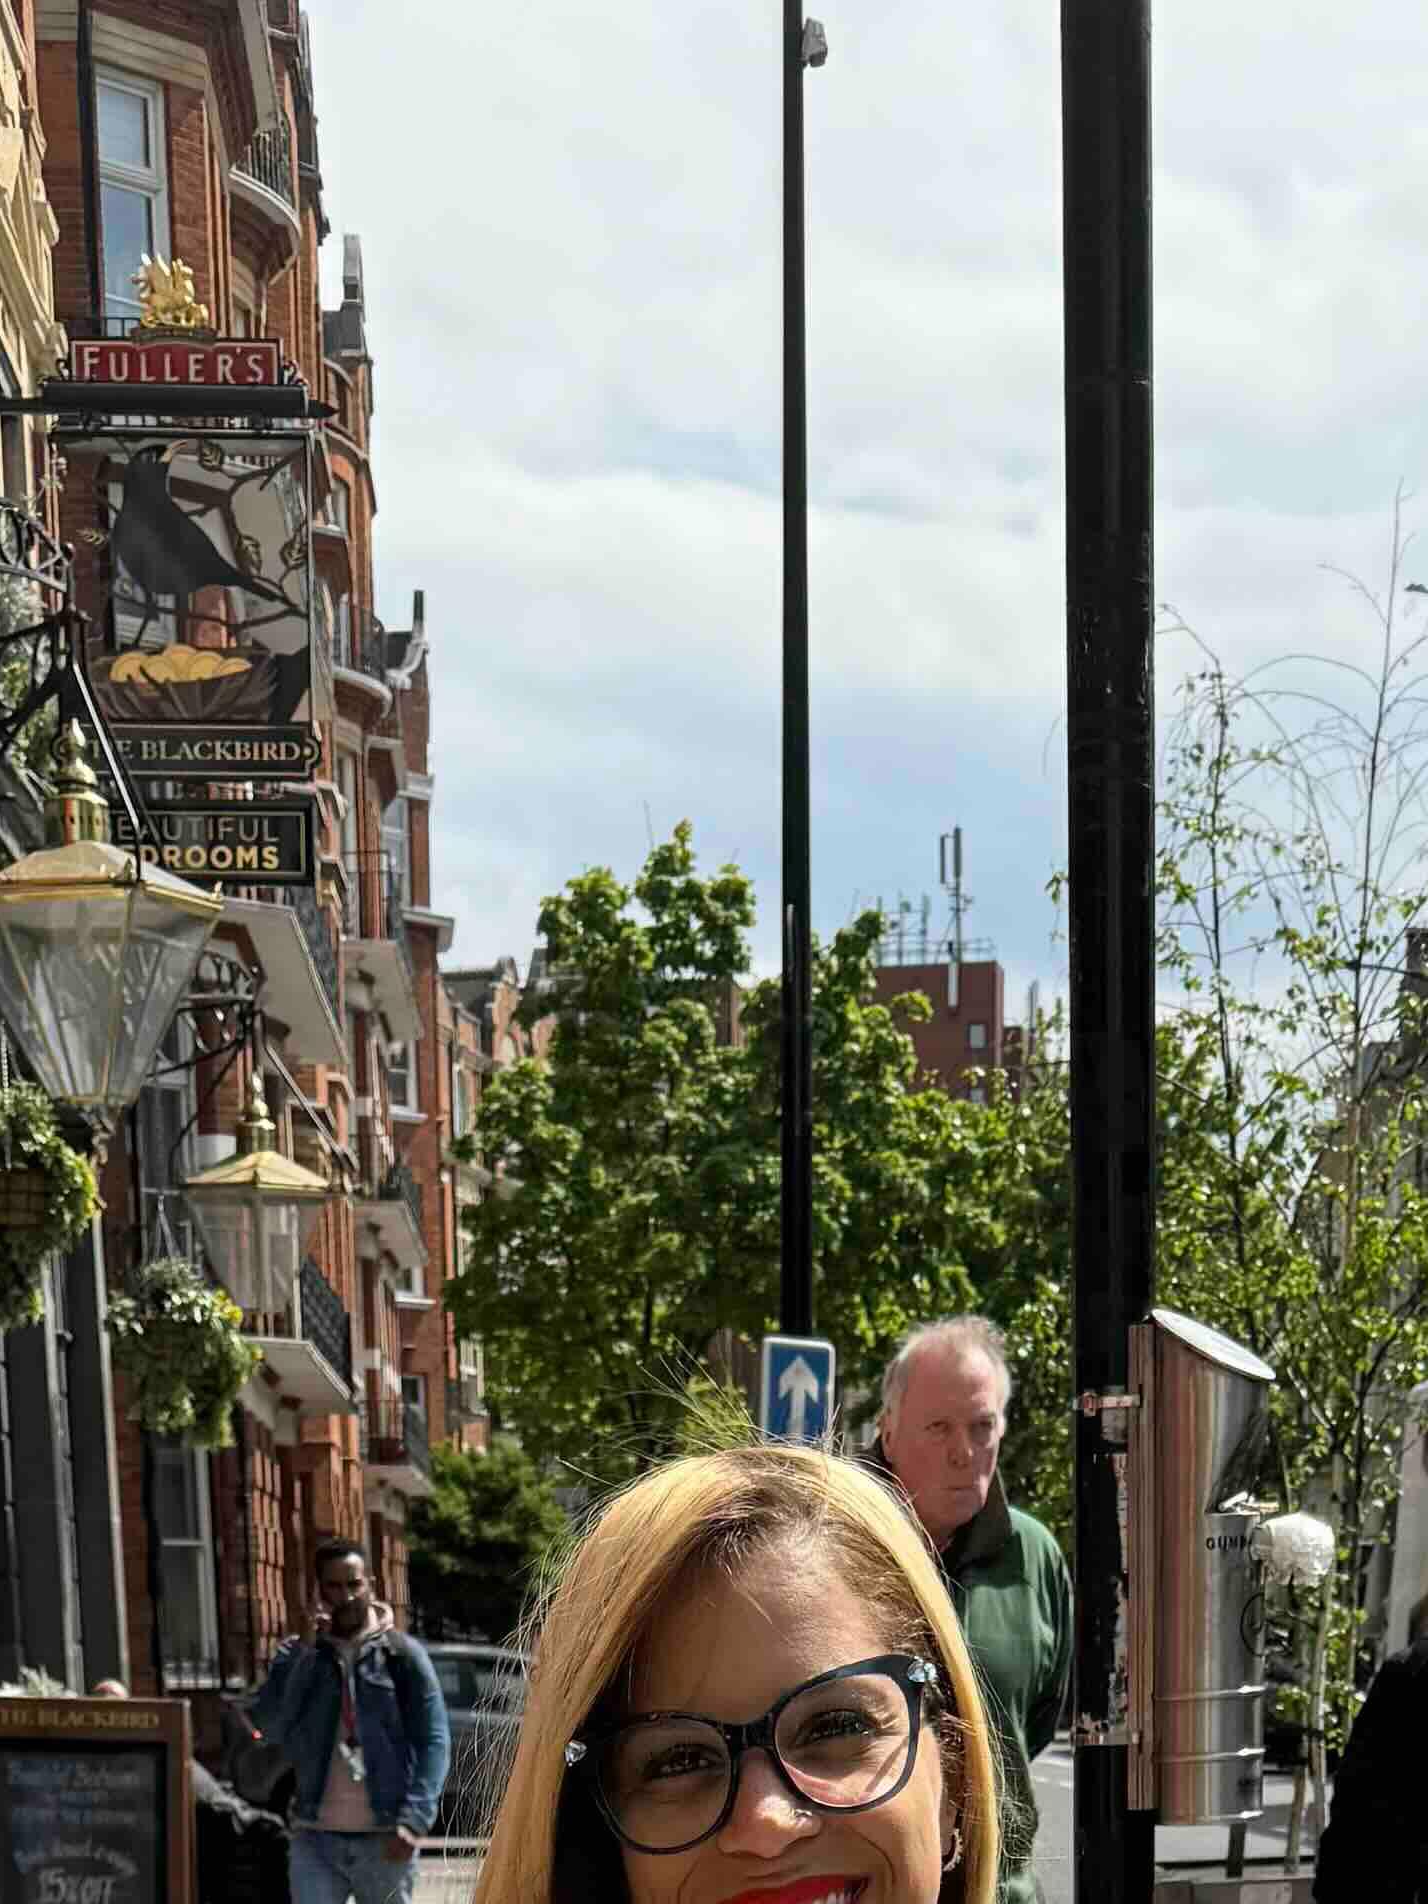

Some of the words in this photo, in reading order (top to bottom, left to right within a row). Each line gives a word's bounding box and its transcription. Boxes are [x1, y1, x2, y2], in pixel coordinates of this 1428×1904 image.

[82, 346, 265, 384] FULLER'S
[140, 737, 301, 762] BLACKBIRD
[116, 815, 281, 843] EAUTIFUL
[124, 844, 281, 870] DROOMS
